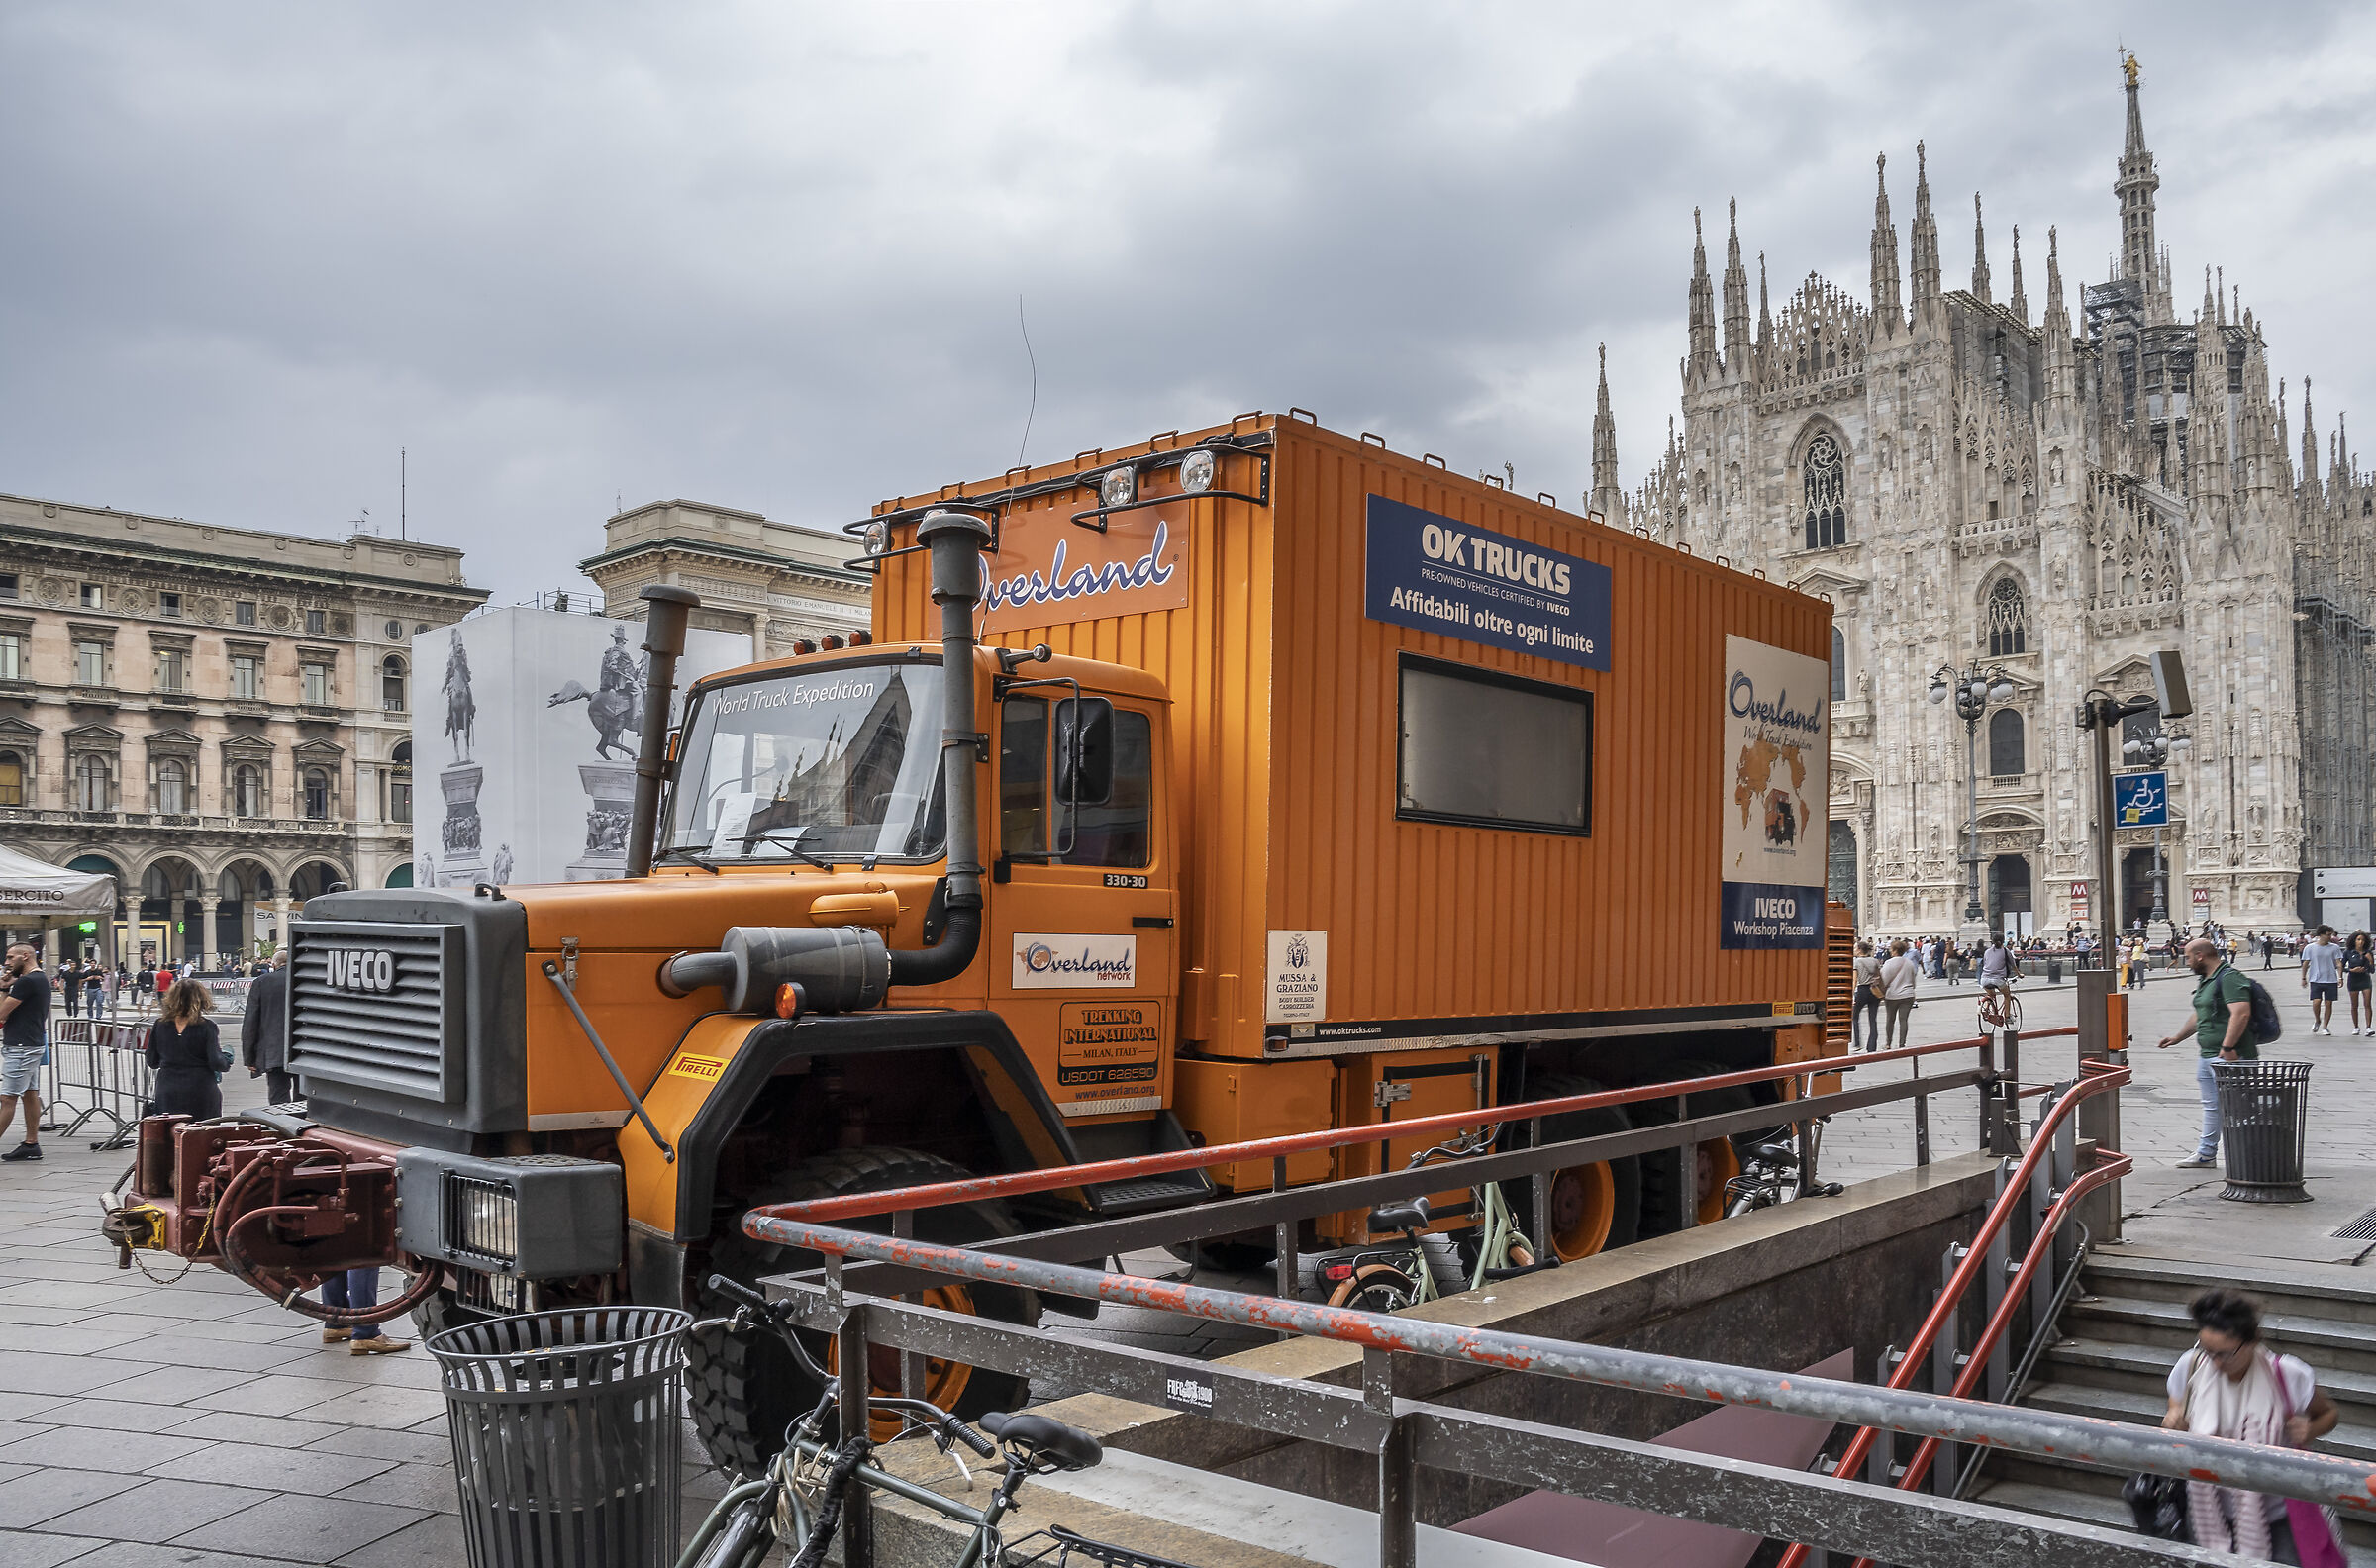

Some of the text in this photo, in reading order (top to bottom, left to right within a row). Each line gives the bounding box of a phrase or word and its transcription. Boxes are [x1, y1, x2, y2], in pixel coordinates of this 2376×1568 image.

[1422, 524, 1571, 595] OK TRUCKS
[1421, 568, 1570, 616] PRE-OWNED VEHICLES CERTIFIED BY IVECO
[773, 596, 802, 607] VITTORIO
[1390, 586, 1594, 654] Affidabili oltre ogni limite
[712, 680, 874, 716] World Truck Expedition
[1729, 669, 1821, 734] Overland
[1754, 897, 1796, 919] IVECO
[1734, 921, 1814, 939] Workshop Piacenza
[1027, 942, 1132, 973] Overland
[326, 950, 394, 990] IVECO
[1097, 971, 1131, 981] network
[1310, 973, 1317, 982] &
[1276, 984, 1319, 993] GRAZIANO
[1082, 1009, 1142, 1025] TREKKING
[1063, 1027, 1157, 1044] INTERNATIONAL
[1319, 1026, 1382, 1035] www.oktrucks.com
[1083, 1049, 1113, 1058] MILAN,
[675, 1057, 723, 1077] PIRELLI
[1061, 1070, 1105, 1083] USDOT
[1075, 1085, 1155, 1100] www.overland.org
